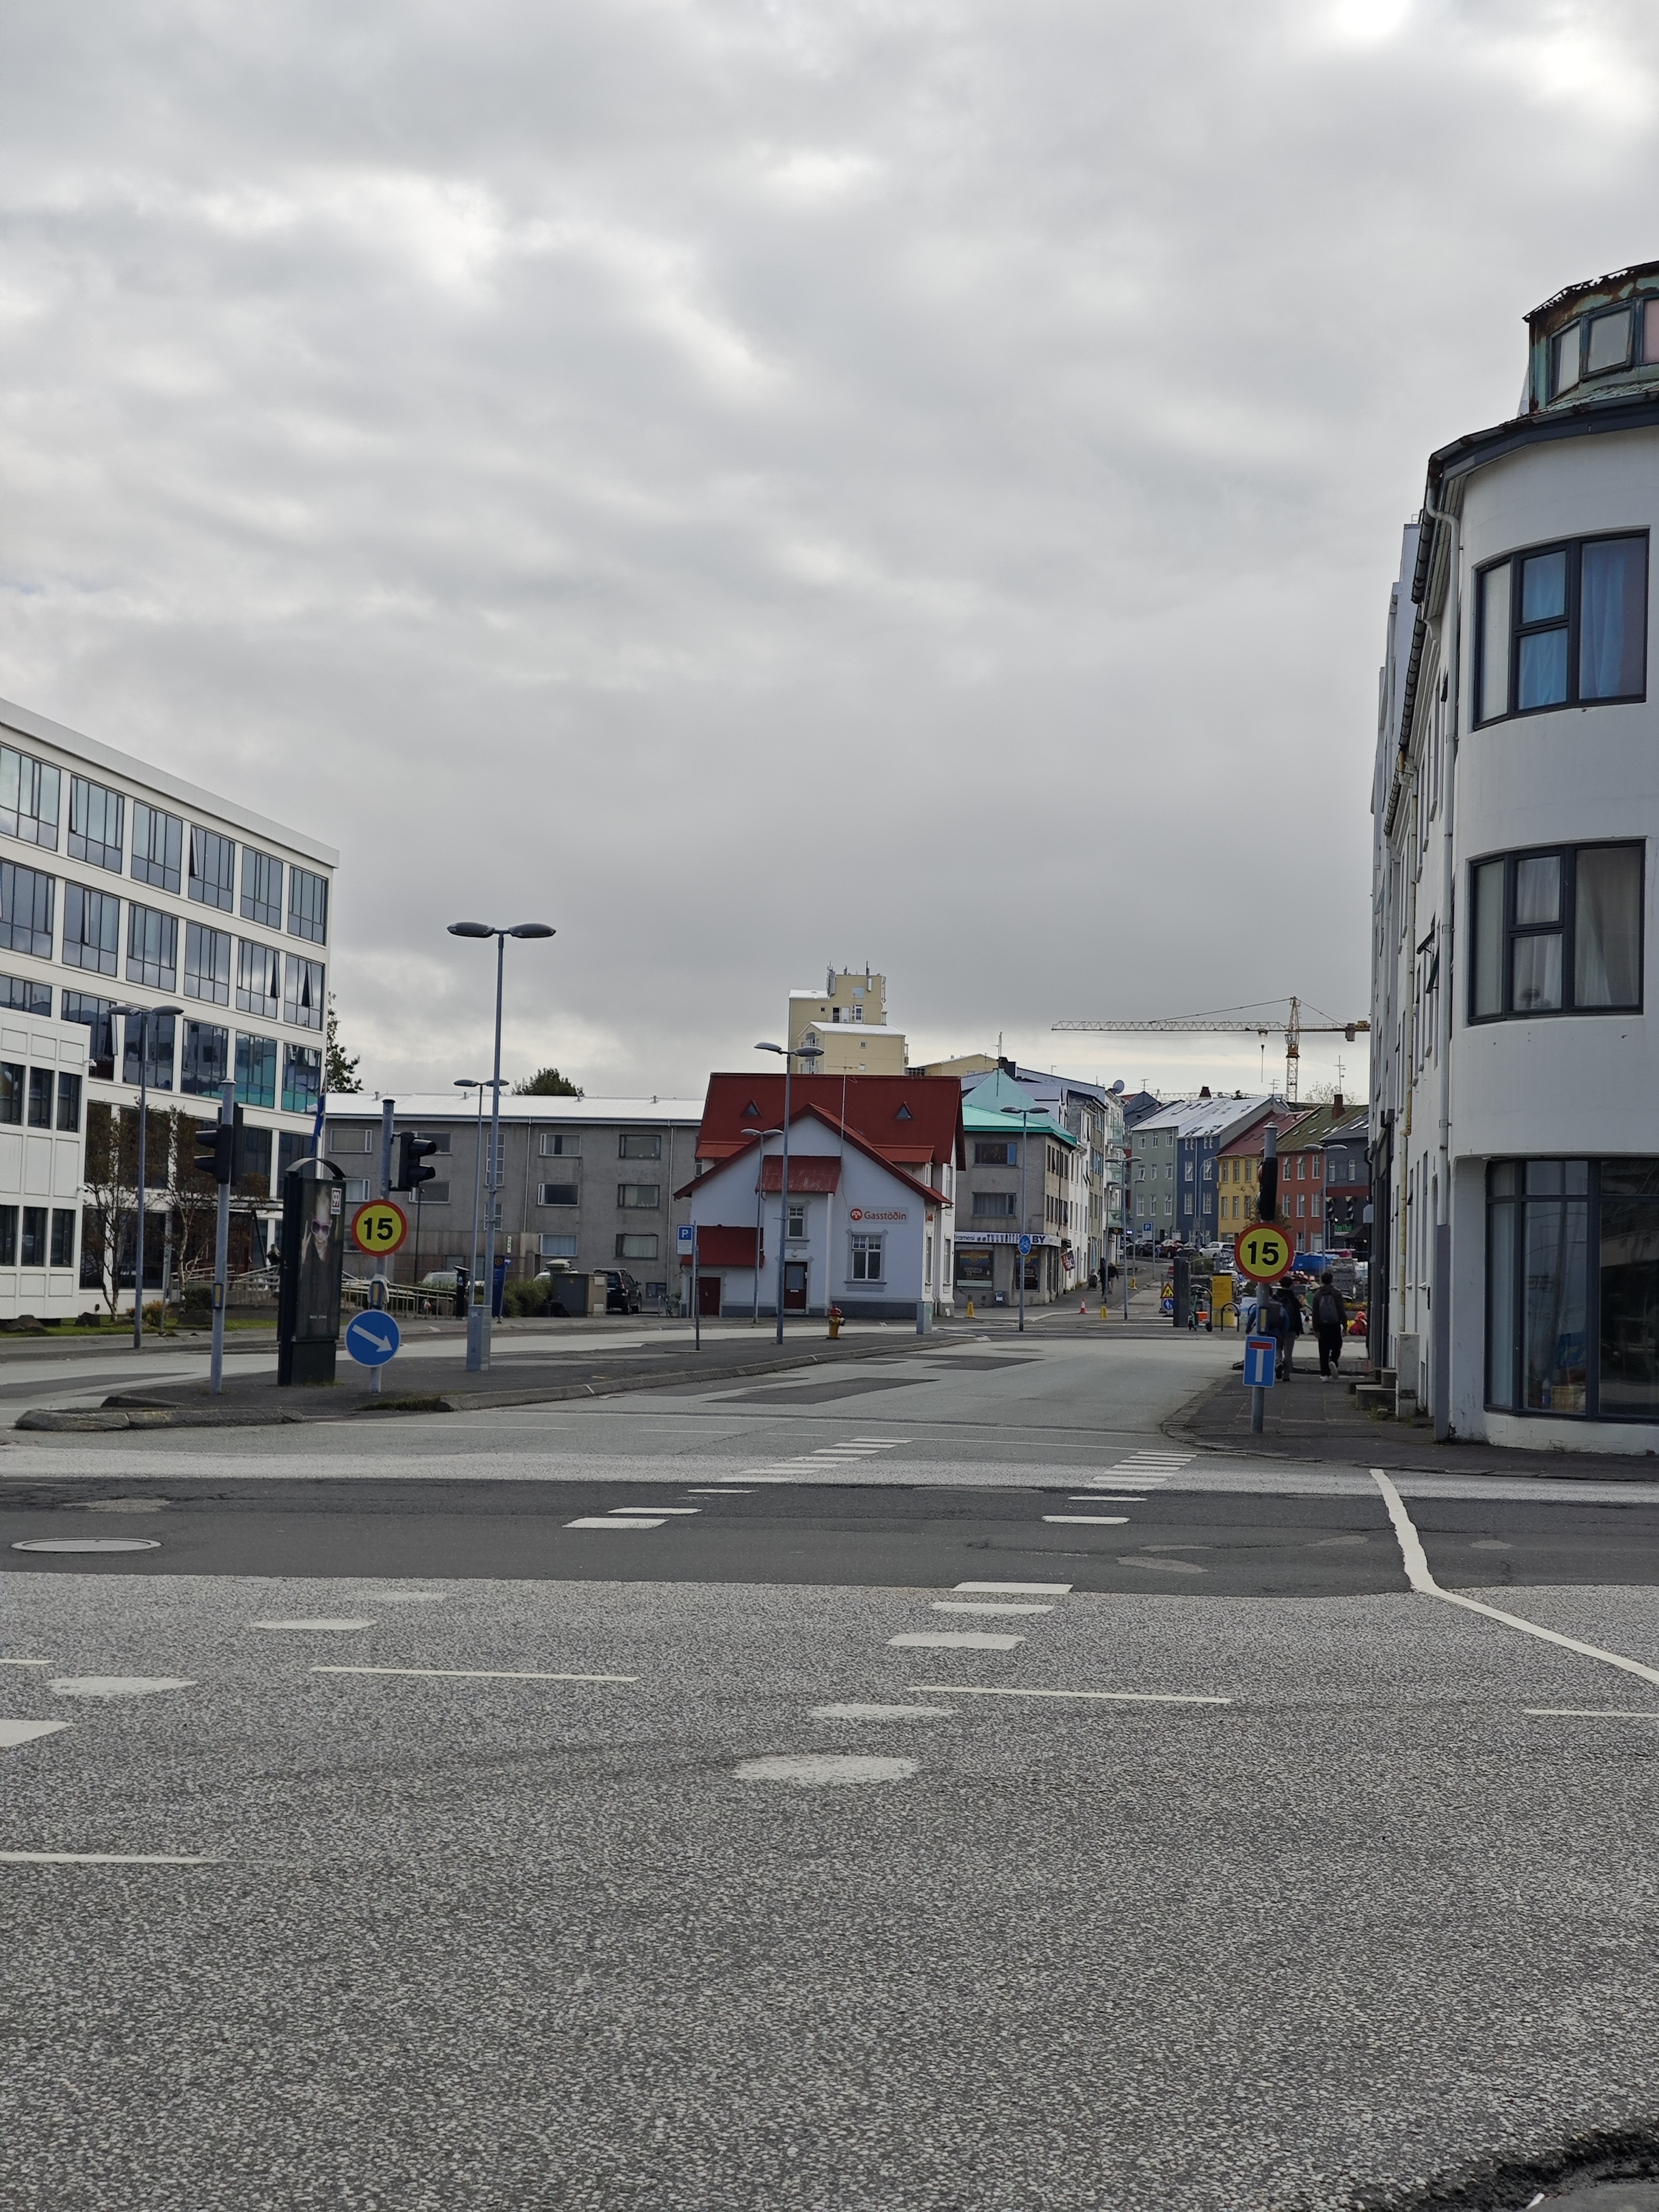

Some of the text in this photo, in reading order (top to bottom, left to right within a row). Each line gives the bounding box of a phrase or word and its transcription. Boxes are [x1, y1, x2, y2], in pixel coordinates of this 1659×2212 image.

[864, 1211, 907, 1220] Gasstöðin
[363, 1217, 393, 1240] 15
[682, 1229, 689, 1238] P
[1032, 1235, 1046, 1244] BY
[1247, 1241, 1279, 1266] 15
